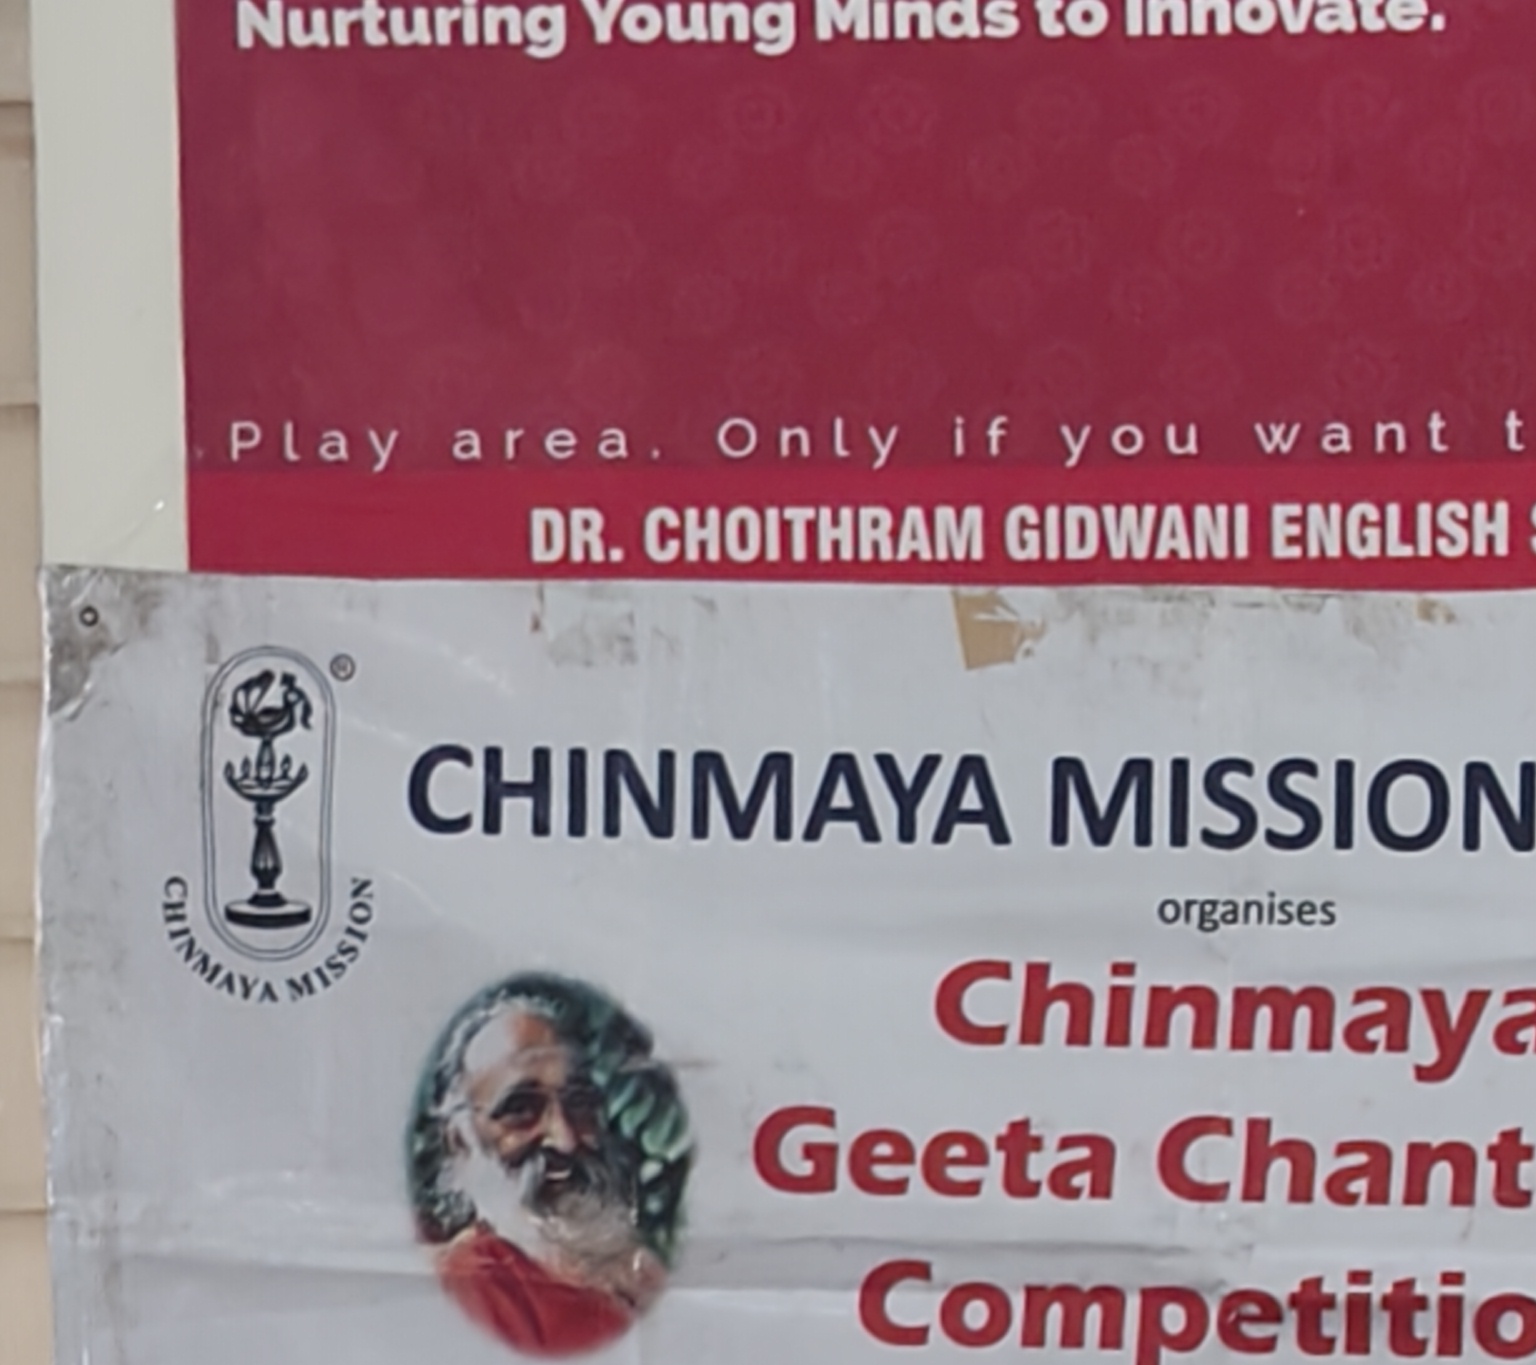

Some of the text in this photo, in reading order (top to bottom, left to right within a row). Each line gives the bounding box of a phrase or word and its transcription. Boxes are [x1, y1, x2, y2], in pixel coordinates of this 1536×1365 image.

[237, 0, 1444, 58] Nurturing Young Minds to Innovate.
[230, 421, 398, 472] Play
[452, 427, 659, 460] area.
[717, 417, 898, 469] Only
[955, 415, 1007, 456] if
[1060, 423, 1198, 468] you
[1254, 411, 1448, 454] want
[530, 507, 624, 563] DR.
[644, 505, 983, 562] CHOITHRAM
[1005, 504, 1248, 561] GIDWANI
[1272, 500, 1509, 559] ENGLISH
[408, 744, 1012, 846] CHINMAYA
[1050, 756, 1536, 852] MISSION
[162, 875, 375, 1004] CHINMAYA MISSION
[1157, 891, 1336, 933] organises
[752, 1105, 1116, 1200] Geeta
